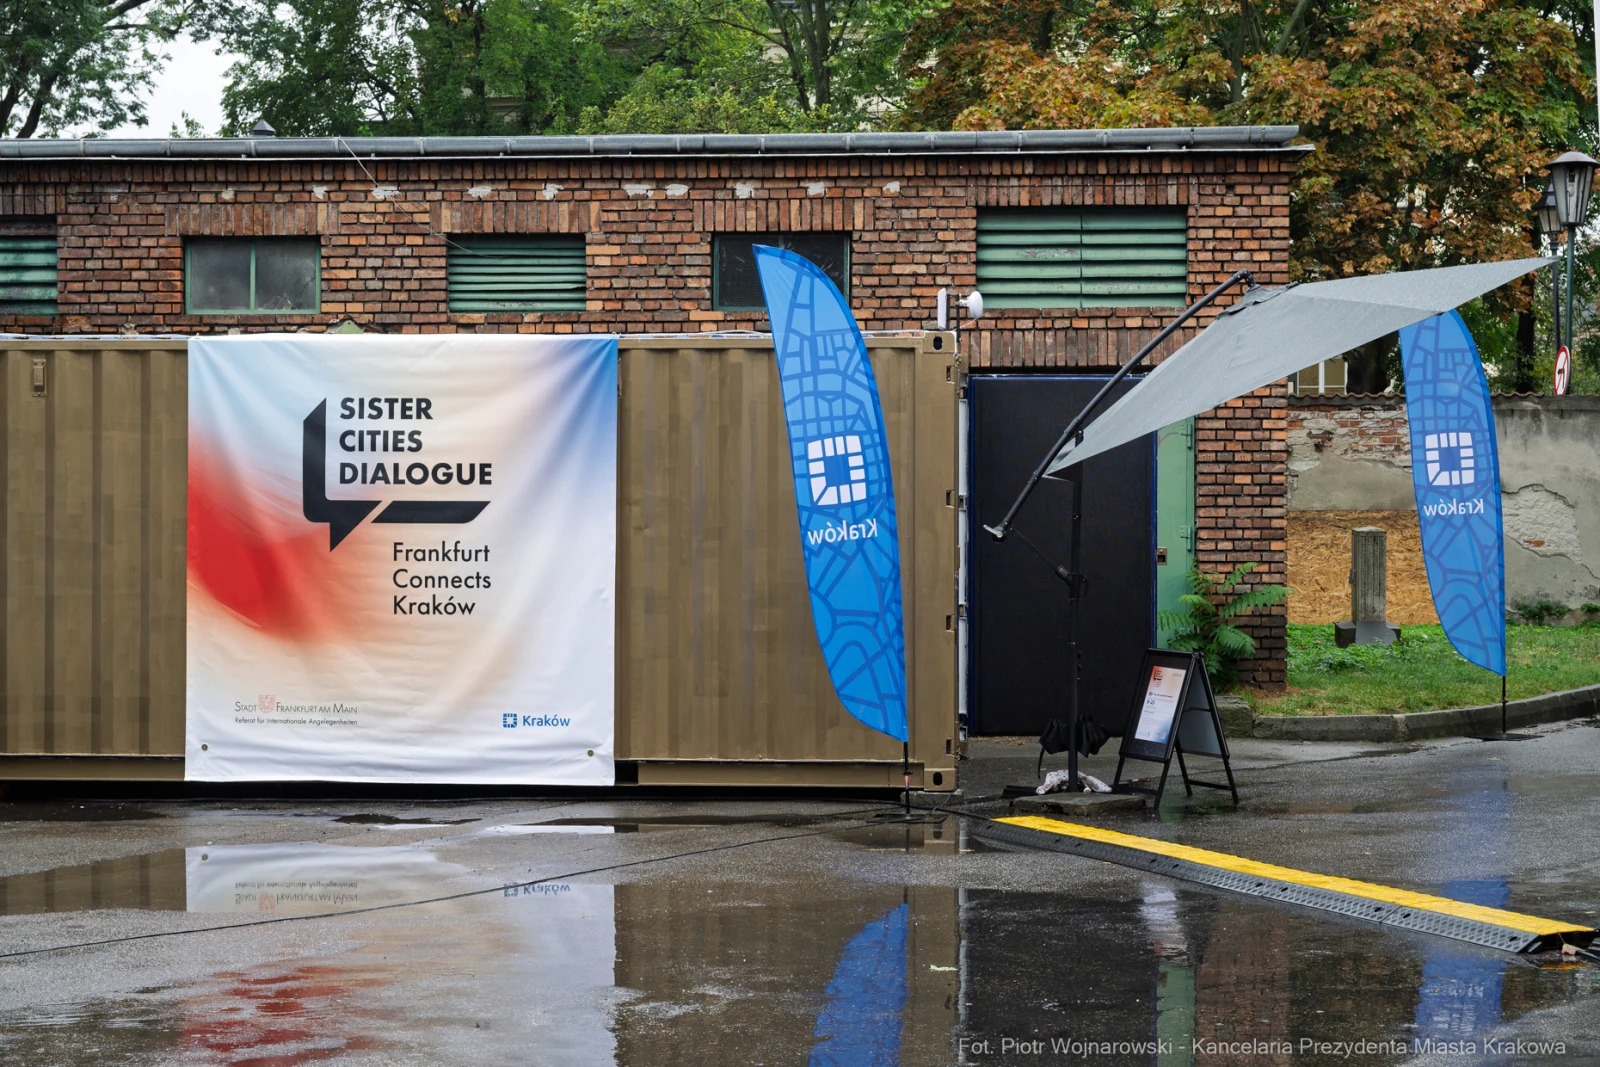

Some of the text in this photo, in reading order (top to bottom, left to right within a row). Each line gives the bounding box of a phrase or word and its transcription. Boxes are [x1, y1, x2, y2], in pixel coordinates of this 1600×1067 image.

[339, 397, 433, 420] SISTER
[339, 429, 423, 453] CITIES
[339, 462, 493, 486] DIALOGUE
[393, 541, 490, 563] Frankfurt
[392, 568, 492, 590] Connects
[393, 593, 476, 616] Kraków
[257, 717, 265, 725] für
[267, 717, 307, 725] Internationale
[308, 718, 358, 727] Angelegenheiten
[522, 714, 571, 727] Kraków
